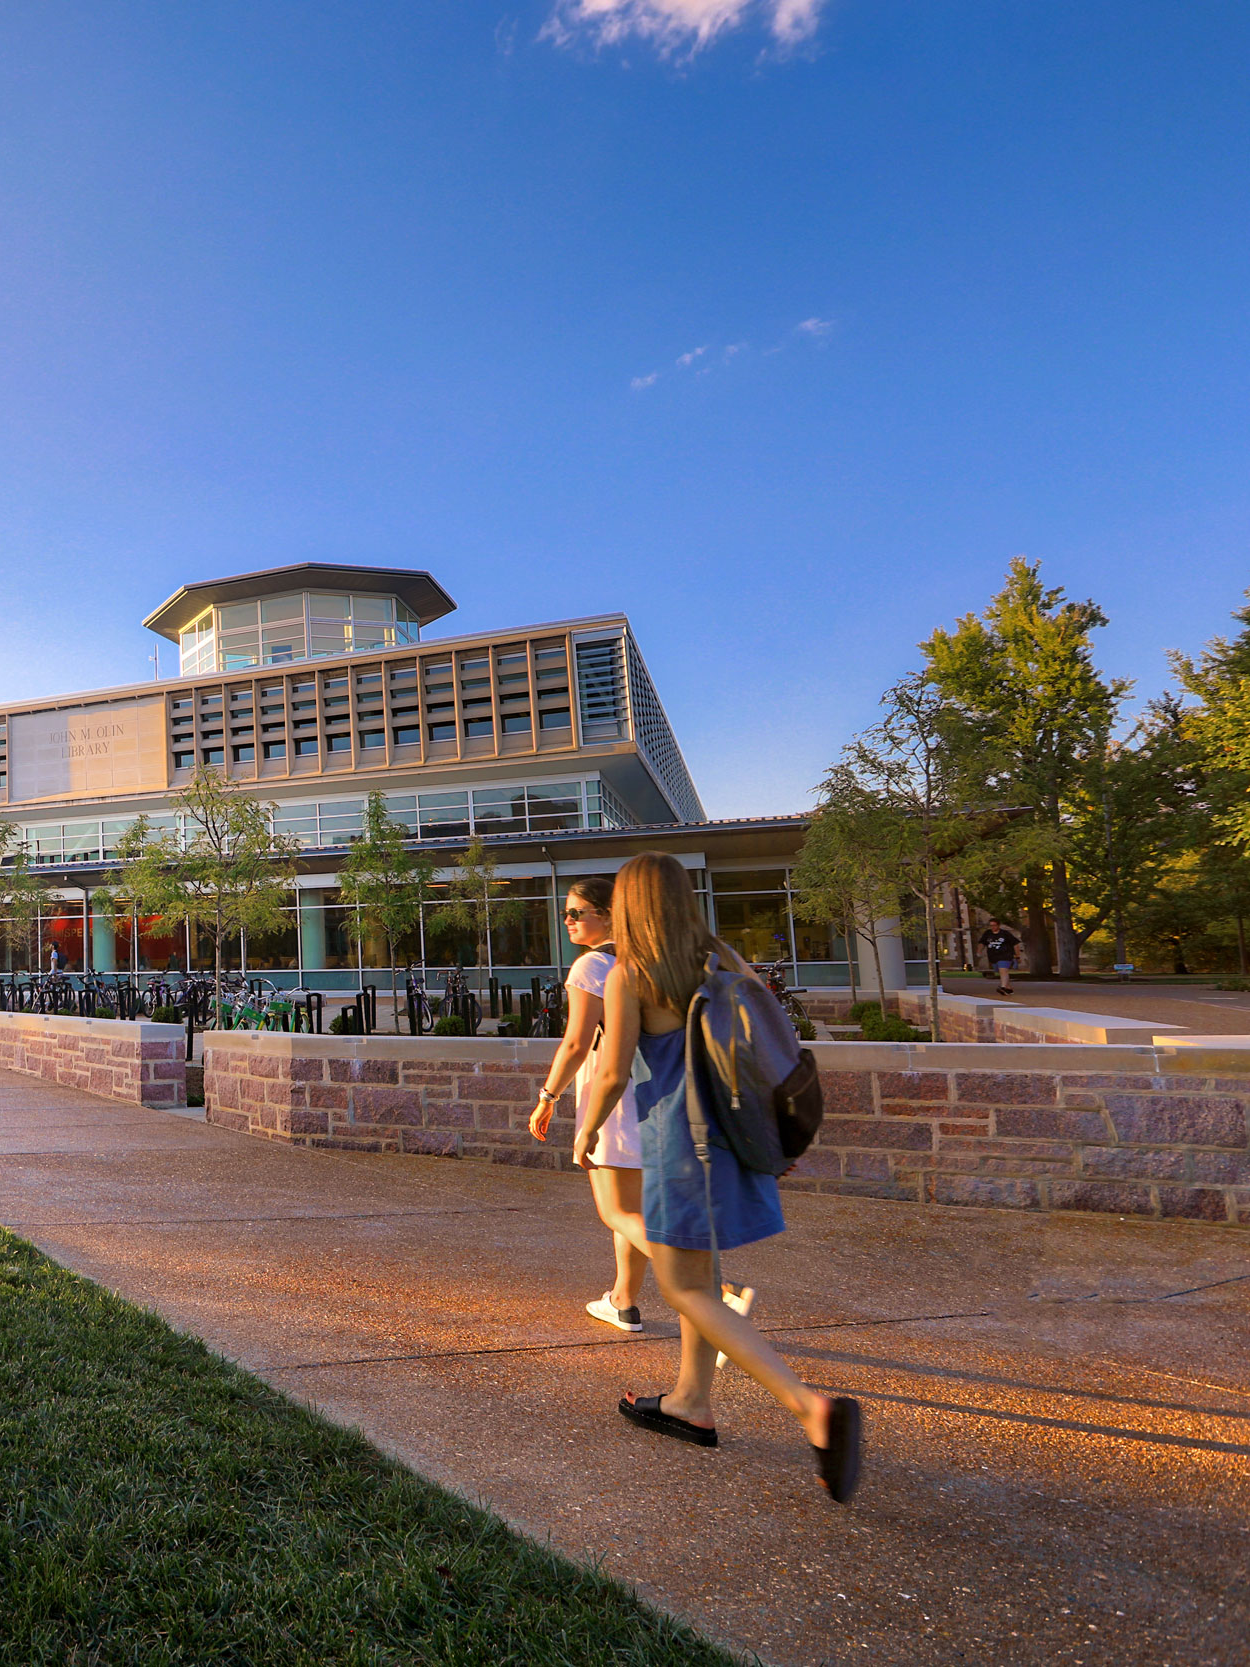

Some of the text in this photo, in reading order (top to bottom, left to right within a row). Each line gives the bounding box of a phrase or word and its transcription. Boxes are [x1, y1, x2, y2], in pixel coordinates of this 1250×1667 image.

[49, 729, 76, 744] JOHN
[96, 724, 124, 738] OLIN
[61, 741, 110, 758] LIBRARY
